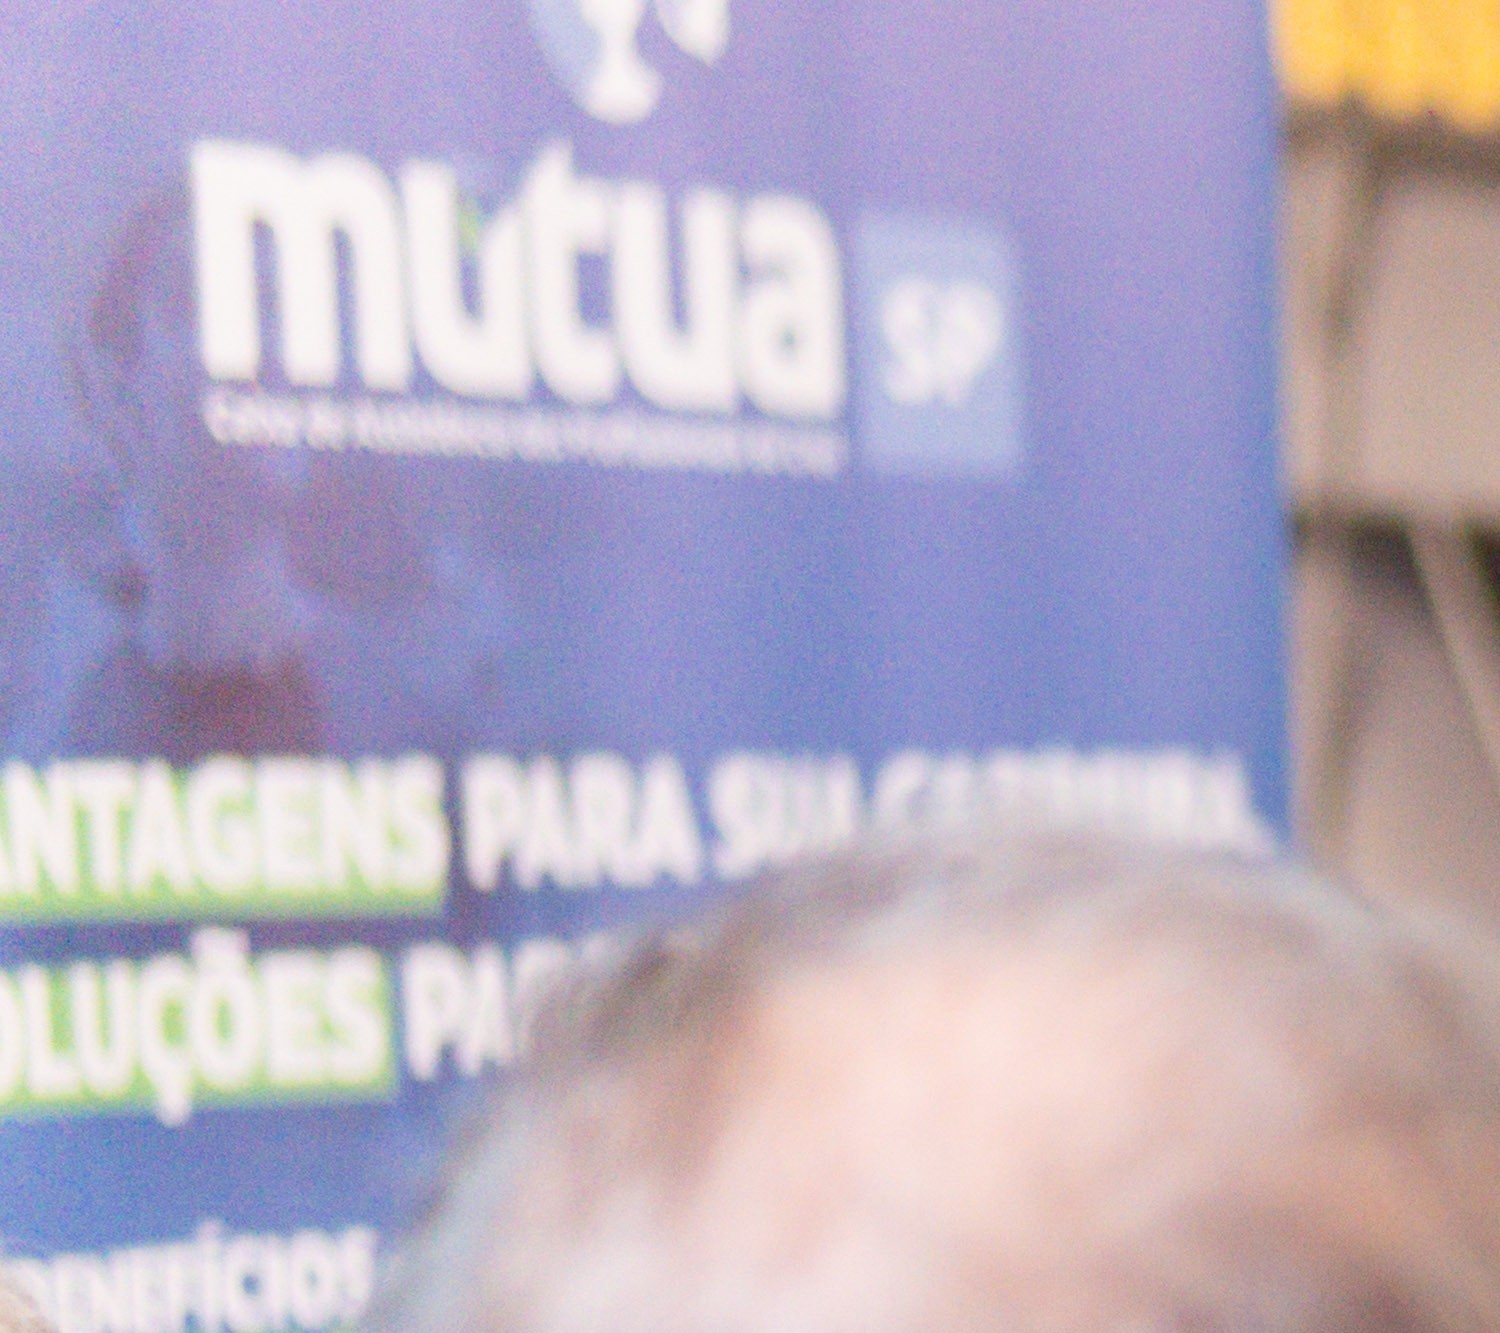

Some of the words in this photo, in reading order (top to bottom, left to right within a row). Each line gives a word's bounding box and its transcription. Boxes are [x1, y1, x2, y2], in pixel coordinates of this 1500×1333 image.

[880, 276, 1002, 406] SP
[0, 754, 447, 896] NTAGENS
[461, 752, 703, 892] PARA
